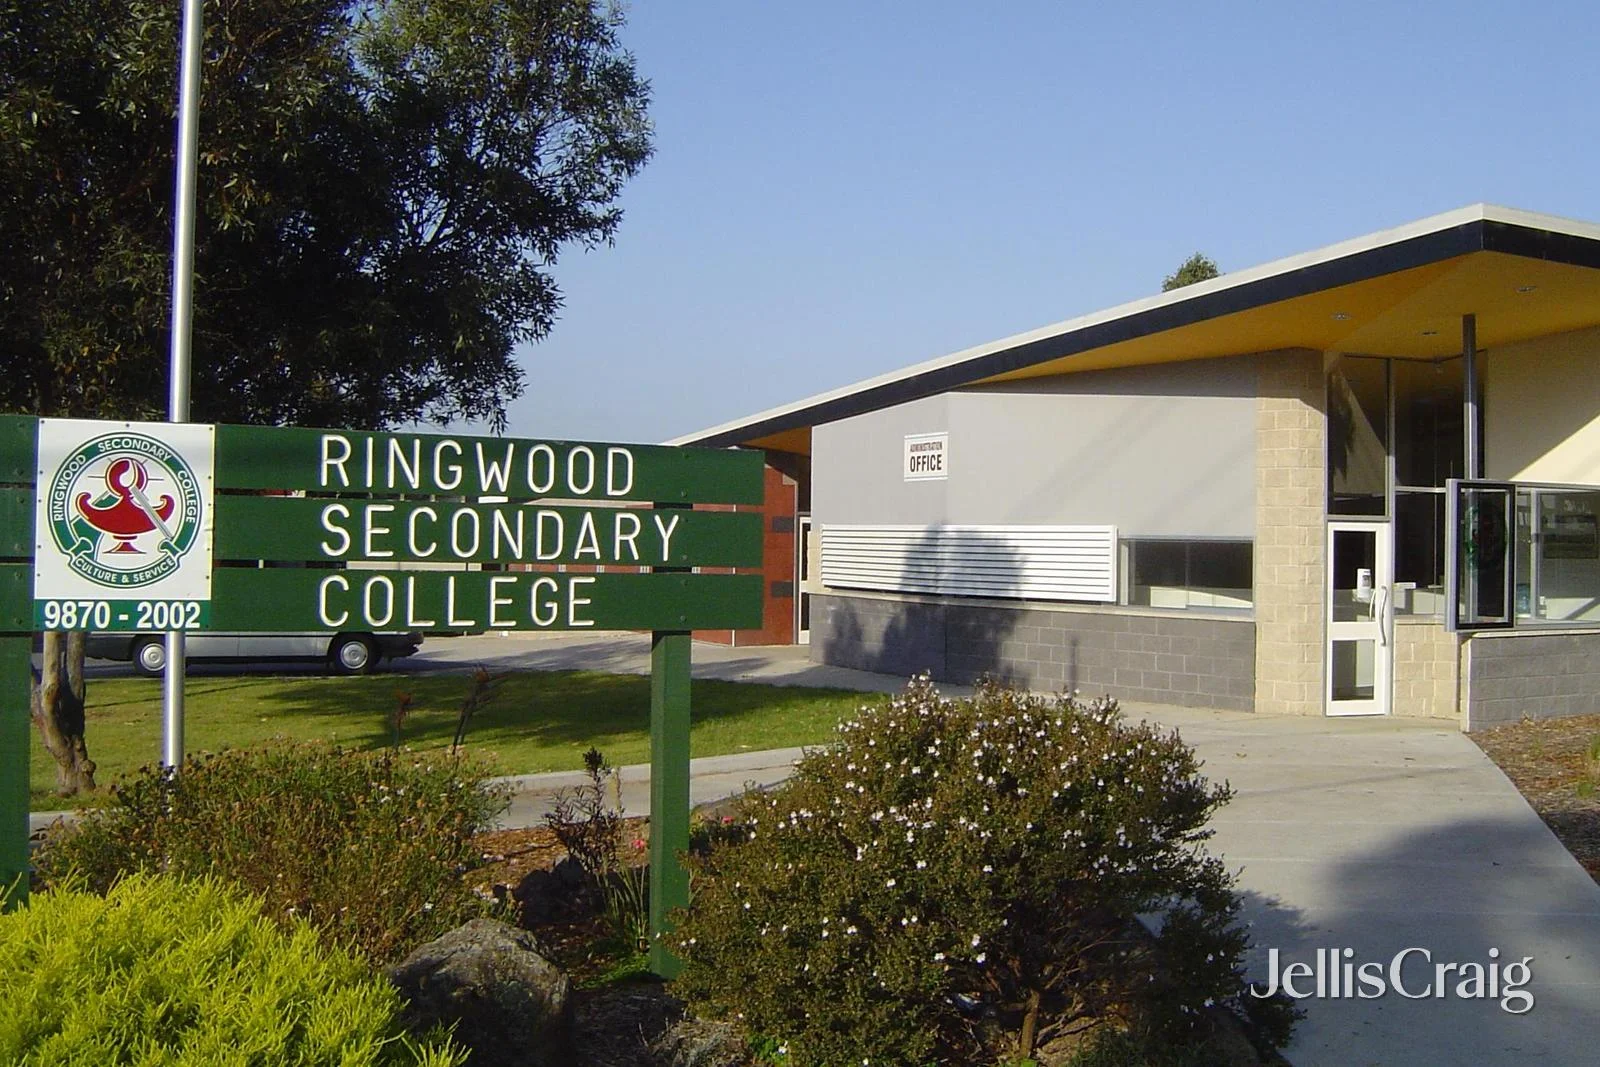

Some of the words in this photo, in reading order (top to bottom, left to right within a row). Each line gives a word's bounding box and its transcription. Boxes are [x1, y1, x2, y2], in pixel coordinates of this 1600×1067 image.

[53, 454, 87, 522] RINGWOOD
[98, 438, 172, 461] SECONDARY
[176, 470, 197, 524] COLLEGE
[320, 434, 634, 495] RINGWOOD
[910, 454, 942, 473] OFFICE
[320, 503, 680, 562] SECONDARY
[75, 557, 117, 583] CULTURE
[121, 574, 130, 584] &
[133, 557, 176, 583] SERVICE
[44, 601, 110, 629] 9870
[136, 601, 201, 629] 2002
[318, 574, 597, 628] COLLEGE
